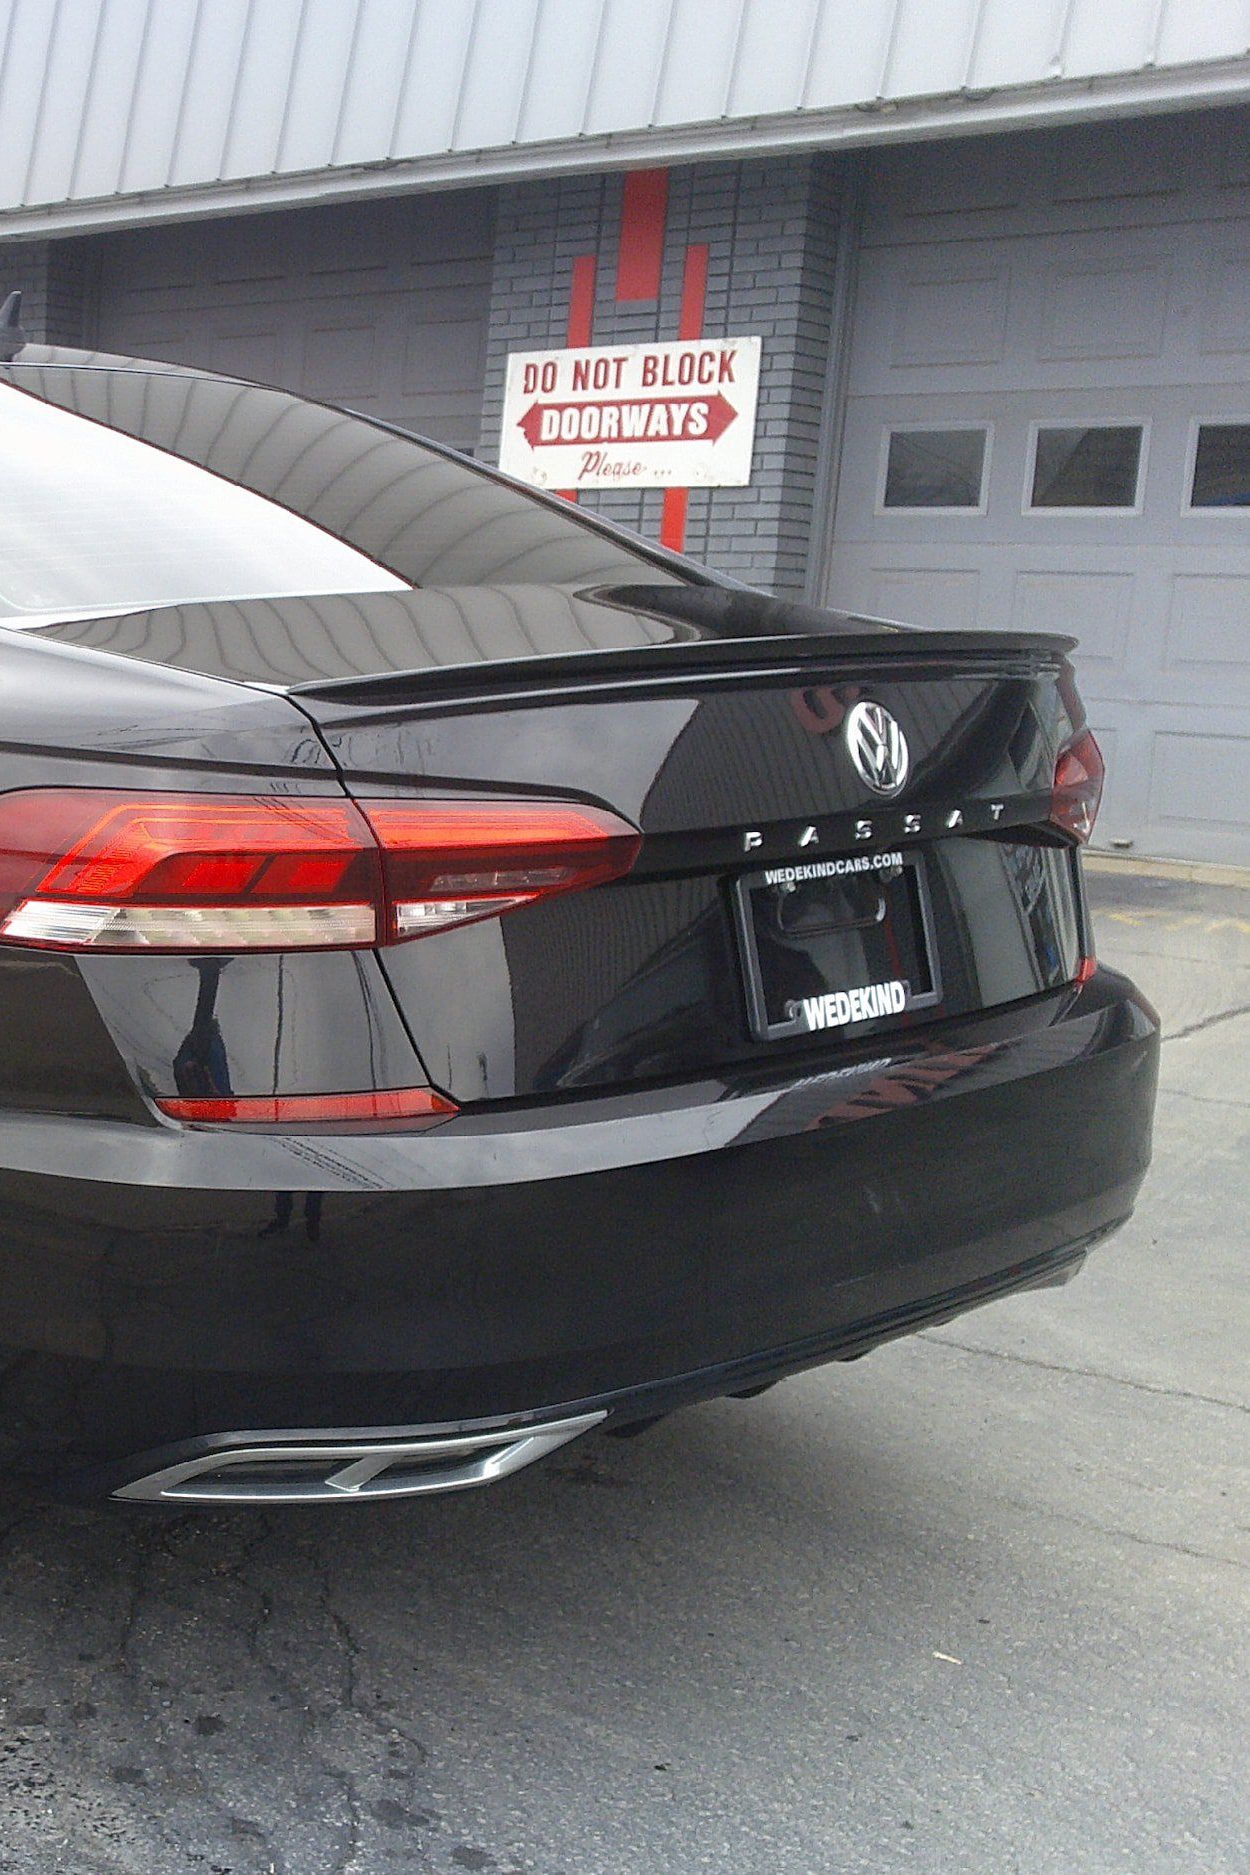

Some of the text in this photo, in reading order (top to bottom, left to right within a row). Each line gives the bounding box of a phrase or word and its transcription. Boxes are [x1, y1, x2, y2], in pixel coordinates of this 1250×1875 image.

[523, 350, 736, 394] DO NOT BLOCK
[541, 402, 710, 442] DOORWAYS
[578, 451, 643, 481] Please
[743, 804, 1005, 852] PASSAT
[765, 852, 904, 885] WEDEKINDCARS.COM
[803, 982, 906, 1031] WEDEKIND
